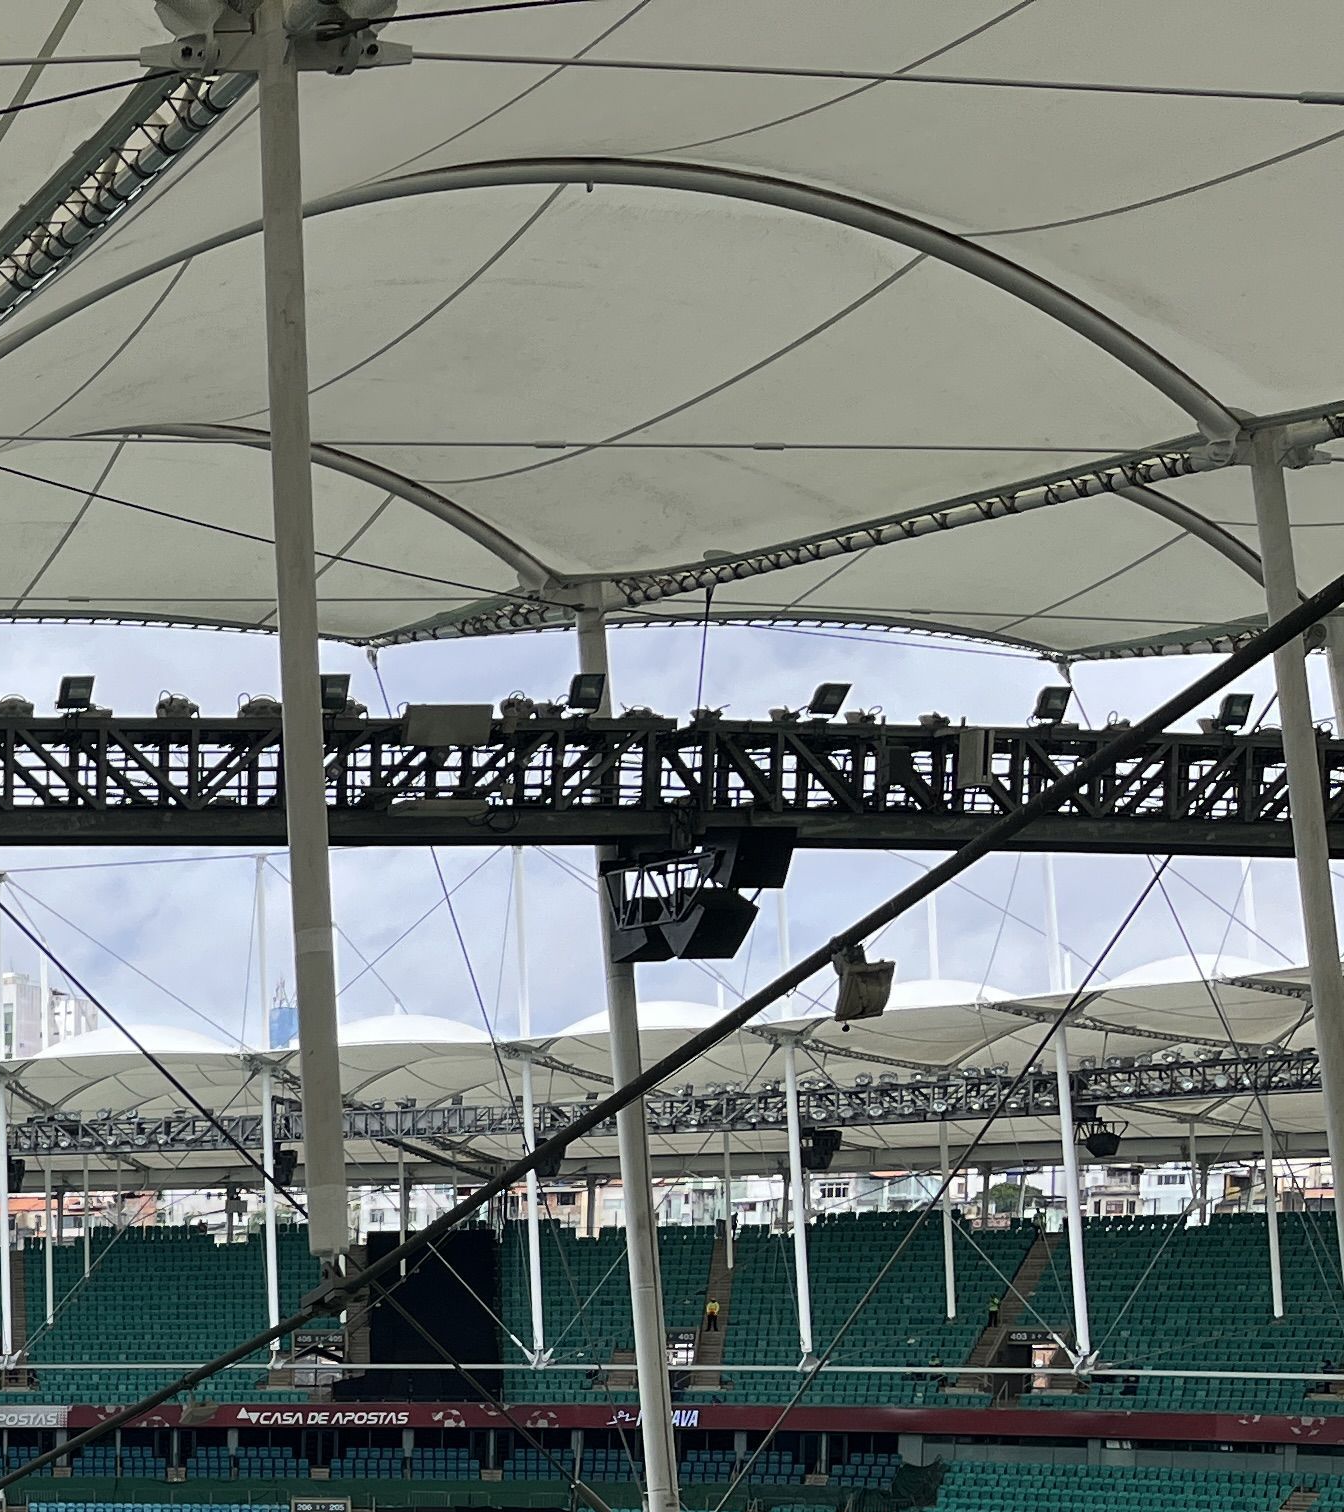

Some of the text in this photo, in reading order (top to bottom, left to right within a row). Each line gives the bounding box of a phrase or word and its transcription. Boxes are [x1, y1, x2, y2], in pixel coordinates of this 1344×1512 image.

[259, 1411, 409, 1425] CASA DE APOSTAS
